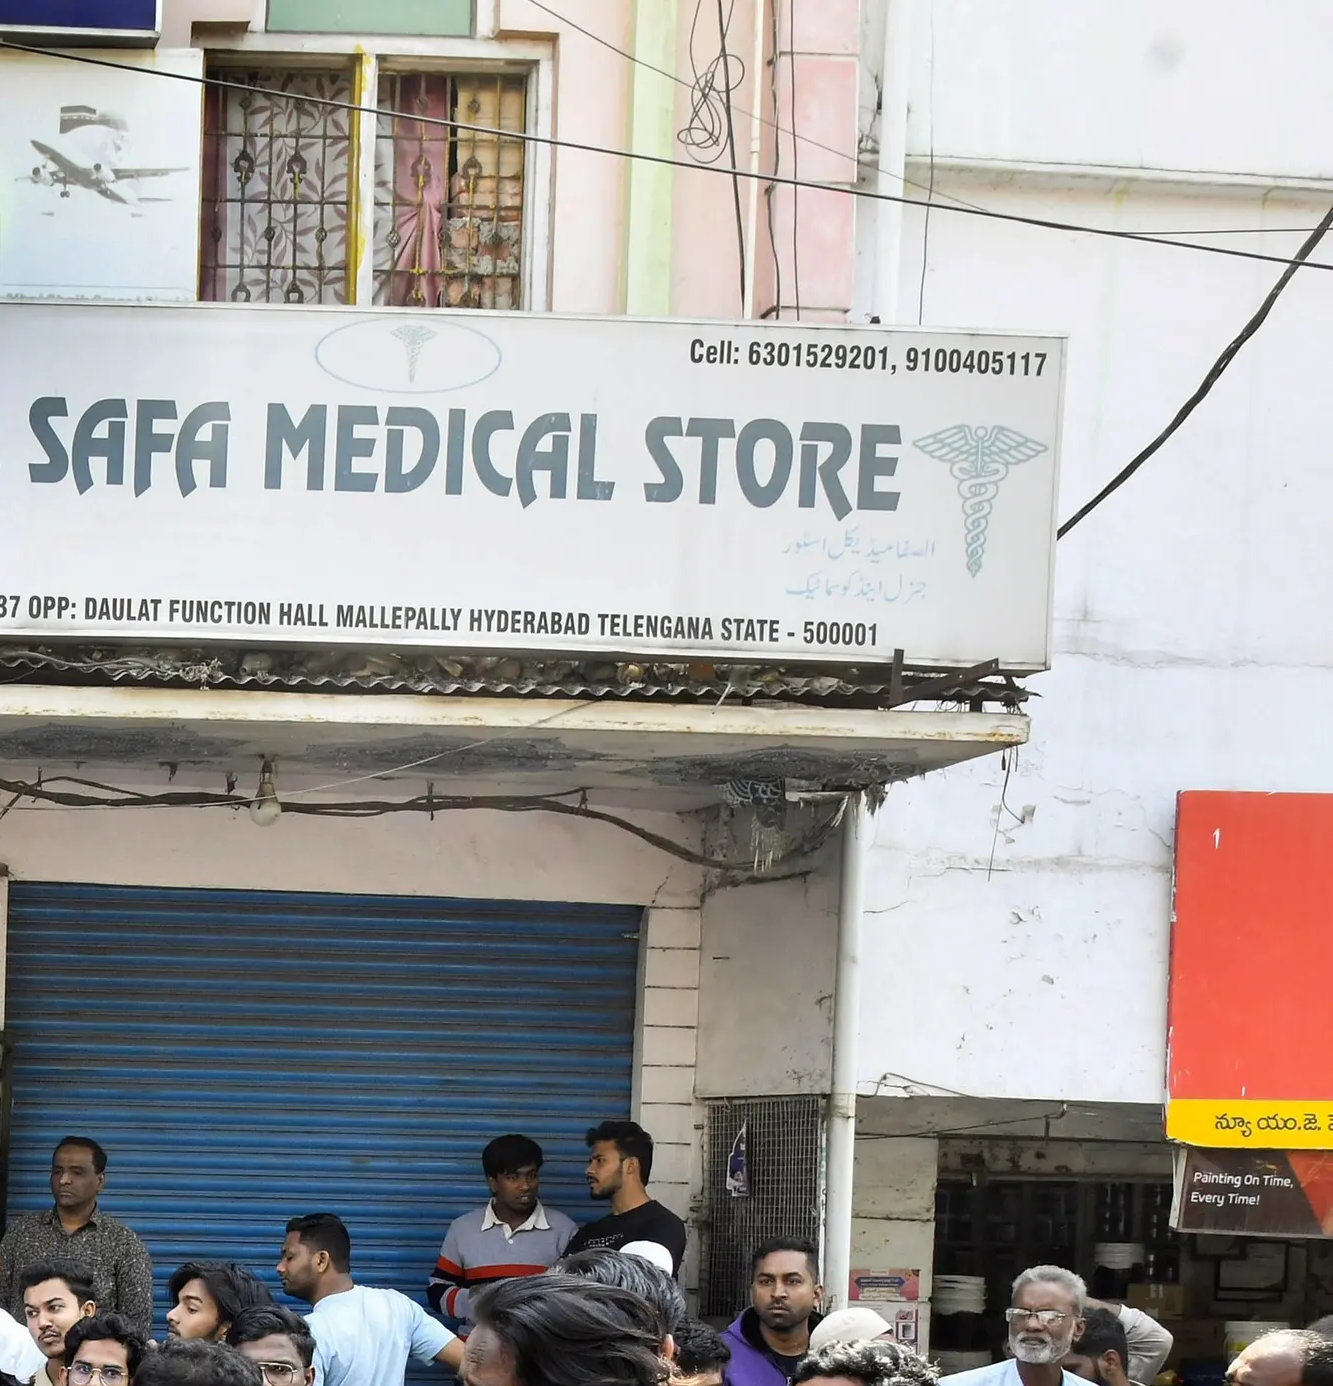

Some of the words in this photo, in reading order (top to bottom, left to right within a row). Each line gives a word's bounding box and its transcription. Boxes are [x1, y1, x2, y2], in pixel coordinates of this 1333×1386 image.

[690, 339, 739, 364] Cell:
[748, 342, 897, 375] 6301529201,
[905, 348, 1047, 377] 9100405117
[28, 396, 232, 498] SAFA
[264, 403, 615, 509] MEDICAL
[644, 416, 902, 521] STORE
[28, 596, 76, 621] OPP:
[84, 597, 162, 622] DAULAT
[169, 600, 271, 625] FUNCTION
[279, 603, 328, 627] HALL
[336, 604, 462, 632] MALLEPALLY
[469, 609, 590, 636] HYDERABAD
[598, 613, 713, 640] TELENGANA
[721, 616, 779, 642] STATE
[803, 621, 878, 647] 500001
[1190, 1191, 1225, 1207] Every
[1228, 1193, 1260, 1206] Time!
[1194, 1171, 1242, 1188] Painting
[1244, 1174, 1260, 1186] On
[1263, 1174, 1294, 1189] Time,
